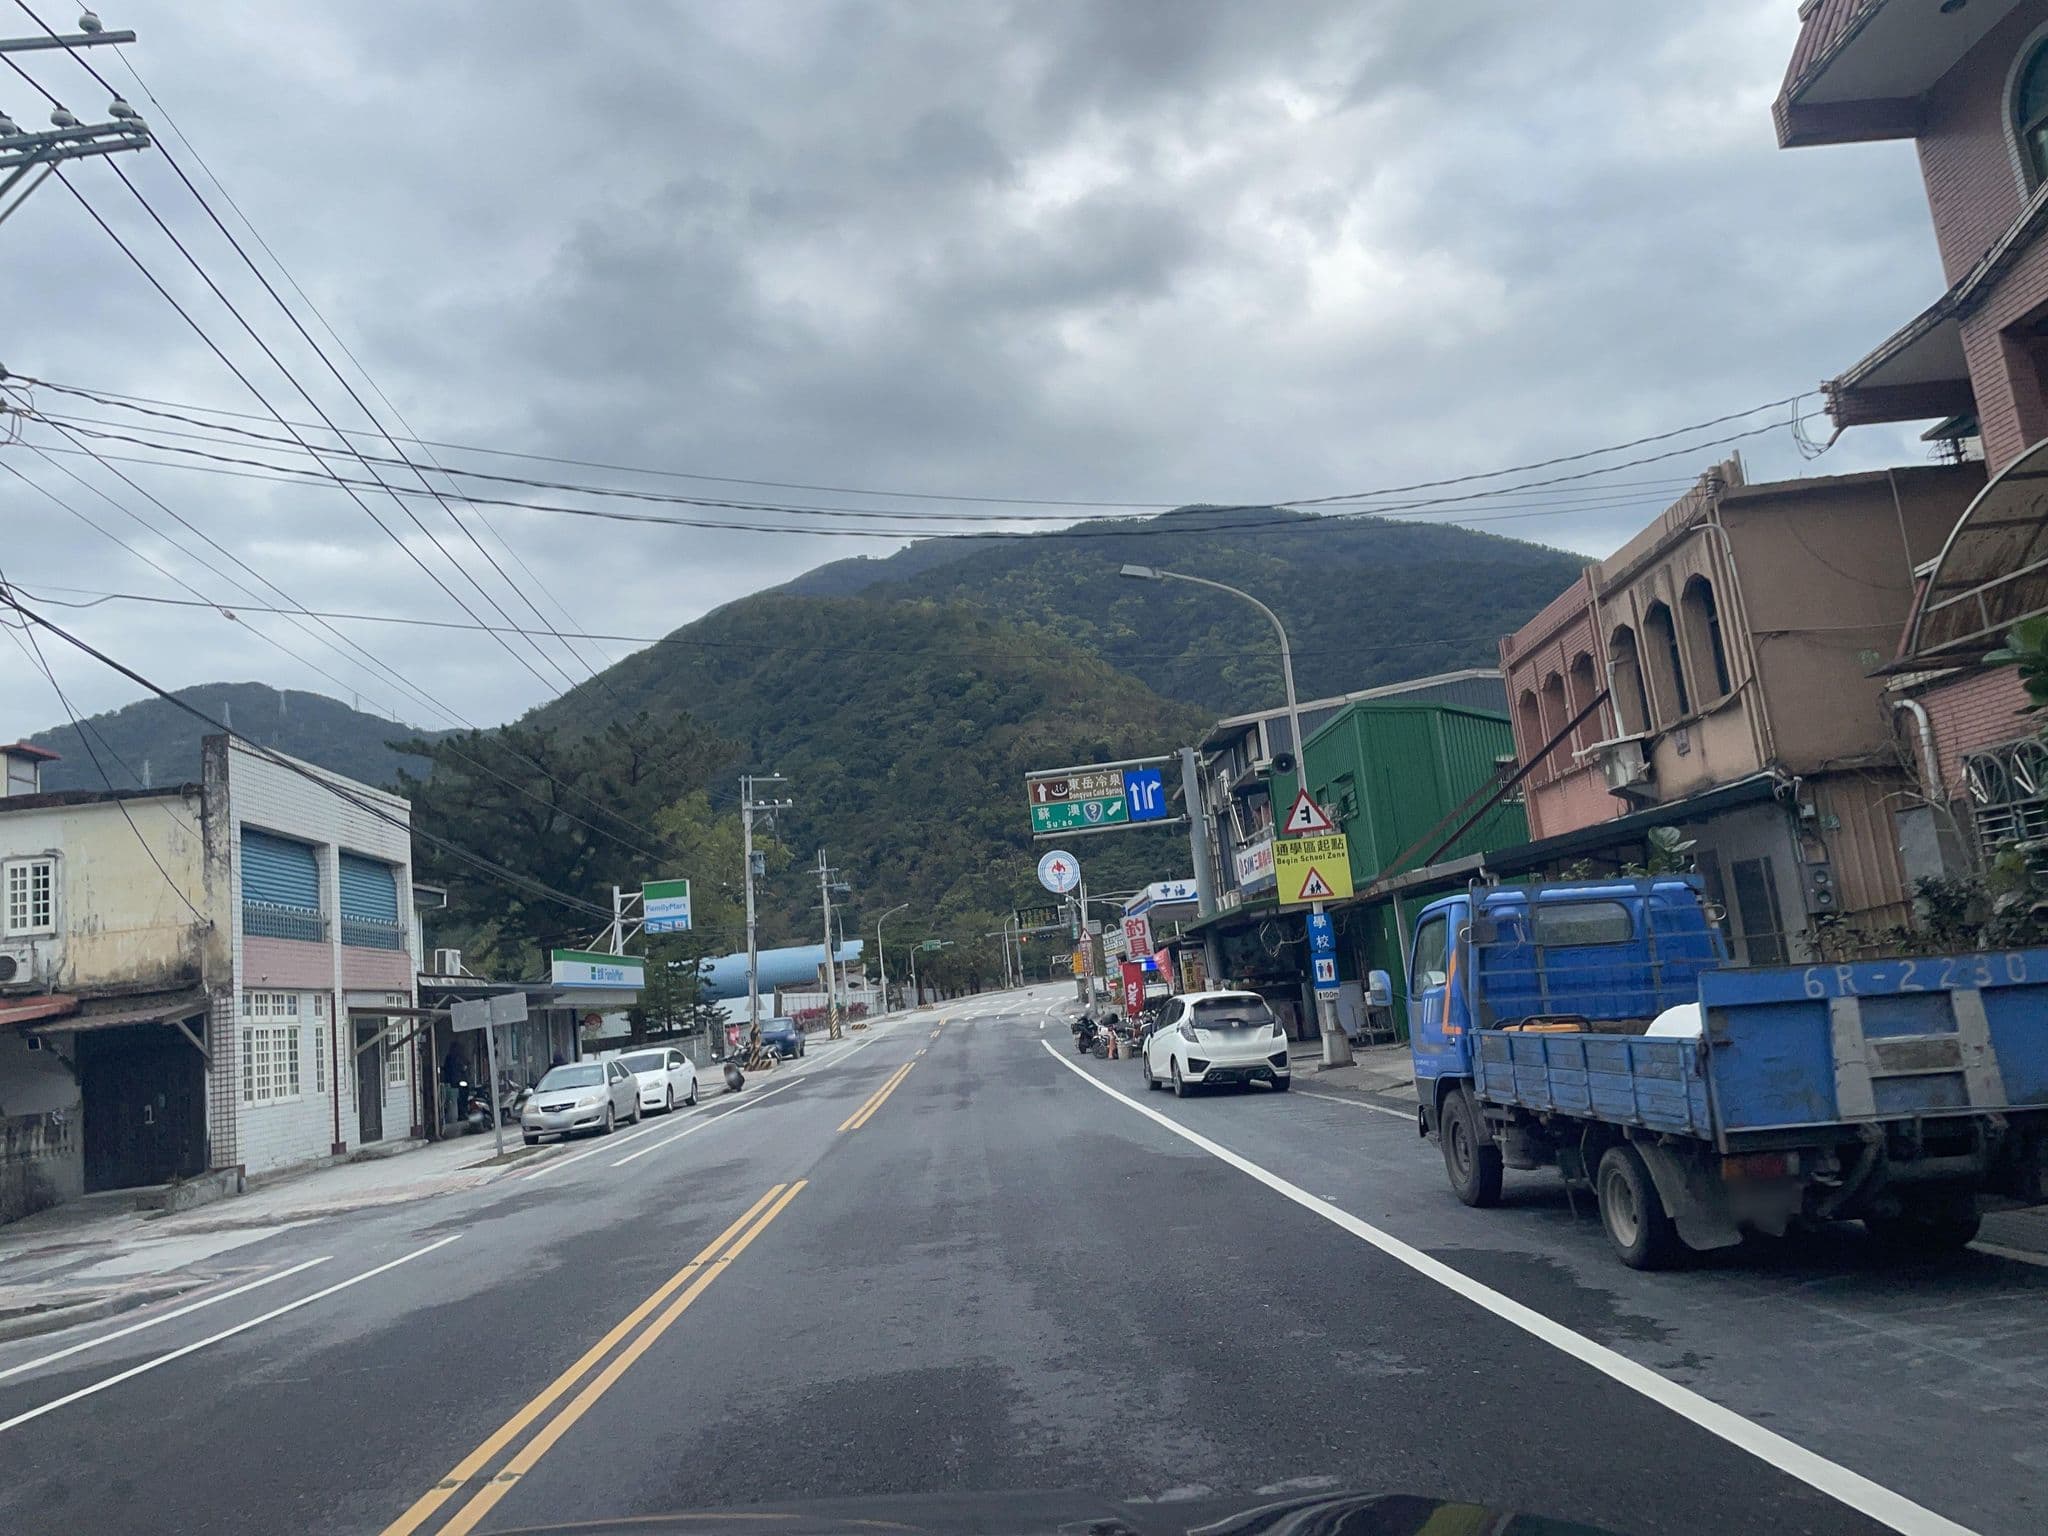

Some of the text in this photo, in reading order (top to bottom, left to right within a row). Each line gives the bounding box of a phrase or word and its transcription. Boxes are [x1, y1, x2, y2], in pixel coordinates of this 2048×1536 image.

[1069, 774, 1121, 790] 東岳冷泉
[1093, 788, 1105, 796] Cold
[1105, 786, 1123, 796] Spring
[1276, 837, 1345, 857] 通學區起點
[1276, 855, 1298, 866] Begin
[1300, 852, 1326, 863] School
[1327, 850, 1345, 860] Zone
[1160, 884, 1186, 897] 中油
[646, 903, 686, 912] FamilyMart
[1125, 918, 1151, 958] 釣具
[1312, 915, 1330, 948] 學校
[1804, 953, 2028, 999] 6R-2230
